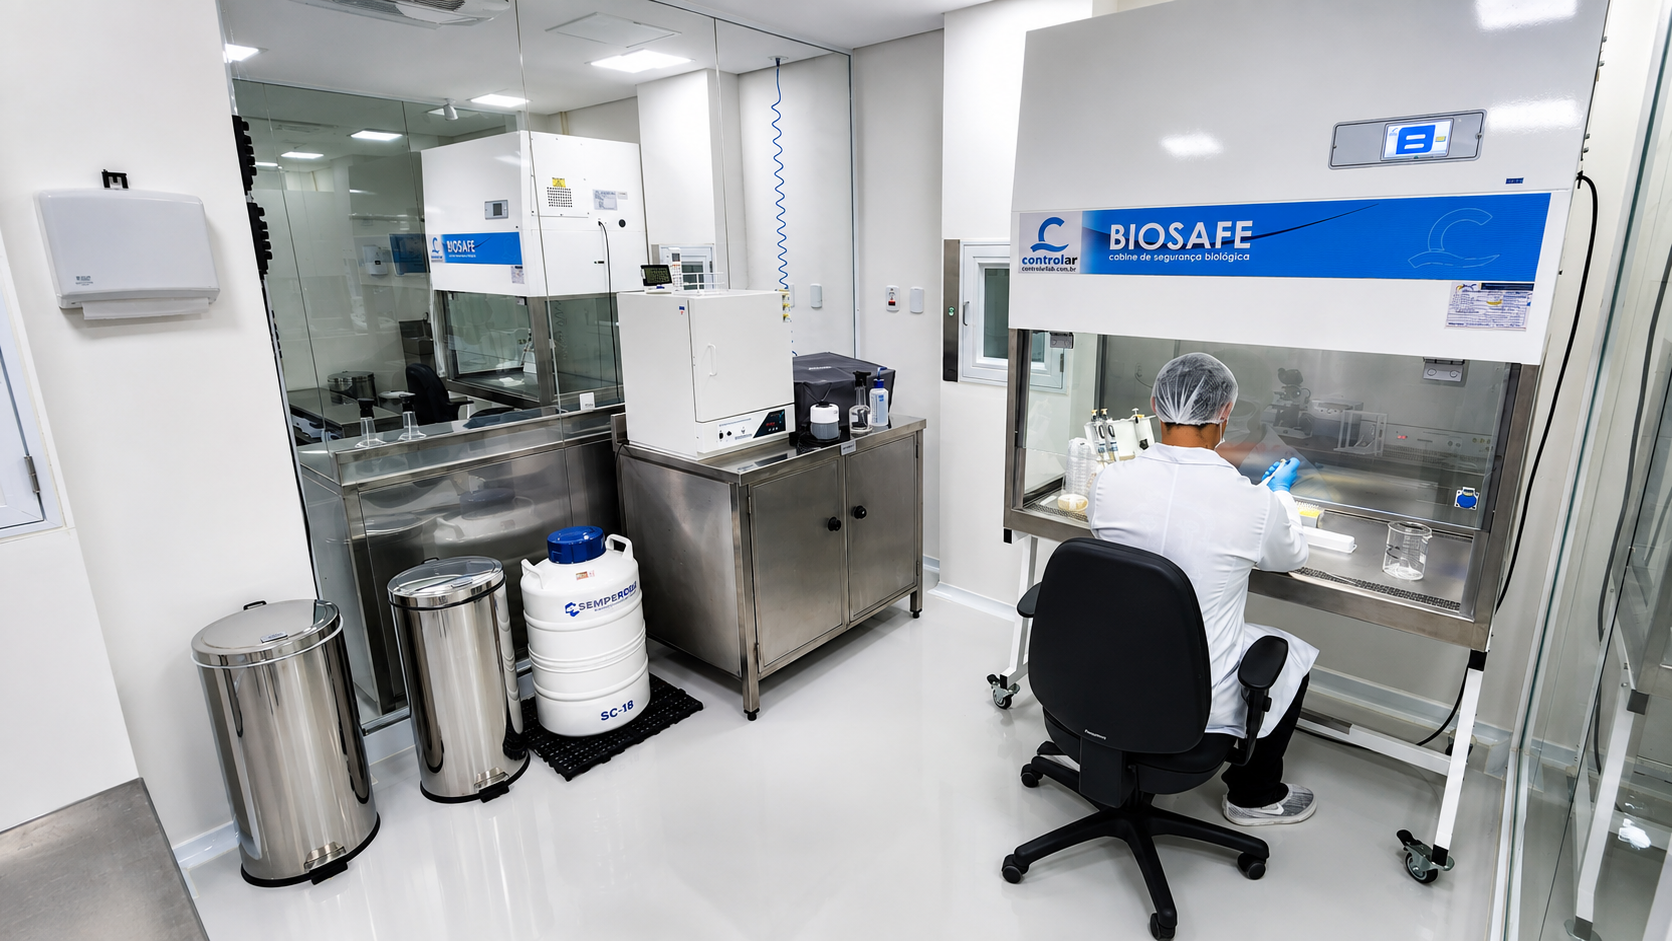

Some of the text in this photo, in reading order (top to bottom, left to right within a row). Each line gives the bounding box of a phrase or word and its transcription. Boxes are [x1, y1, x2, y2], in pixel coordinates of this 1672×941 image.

[1109, 220, 1253, 250] BIOSAFE
[1021, 253, 1078, 266] controlar
[1108, 251, 1250, 264] cabine de segurança biológica
[600, 700, 634, 721] SC-18
